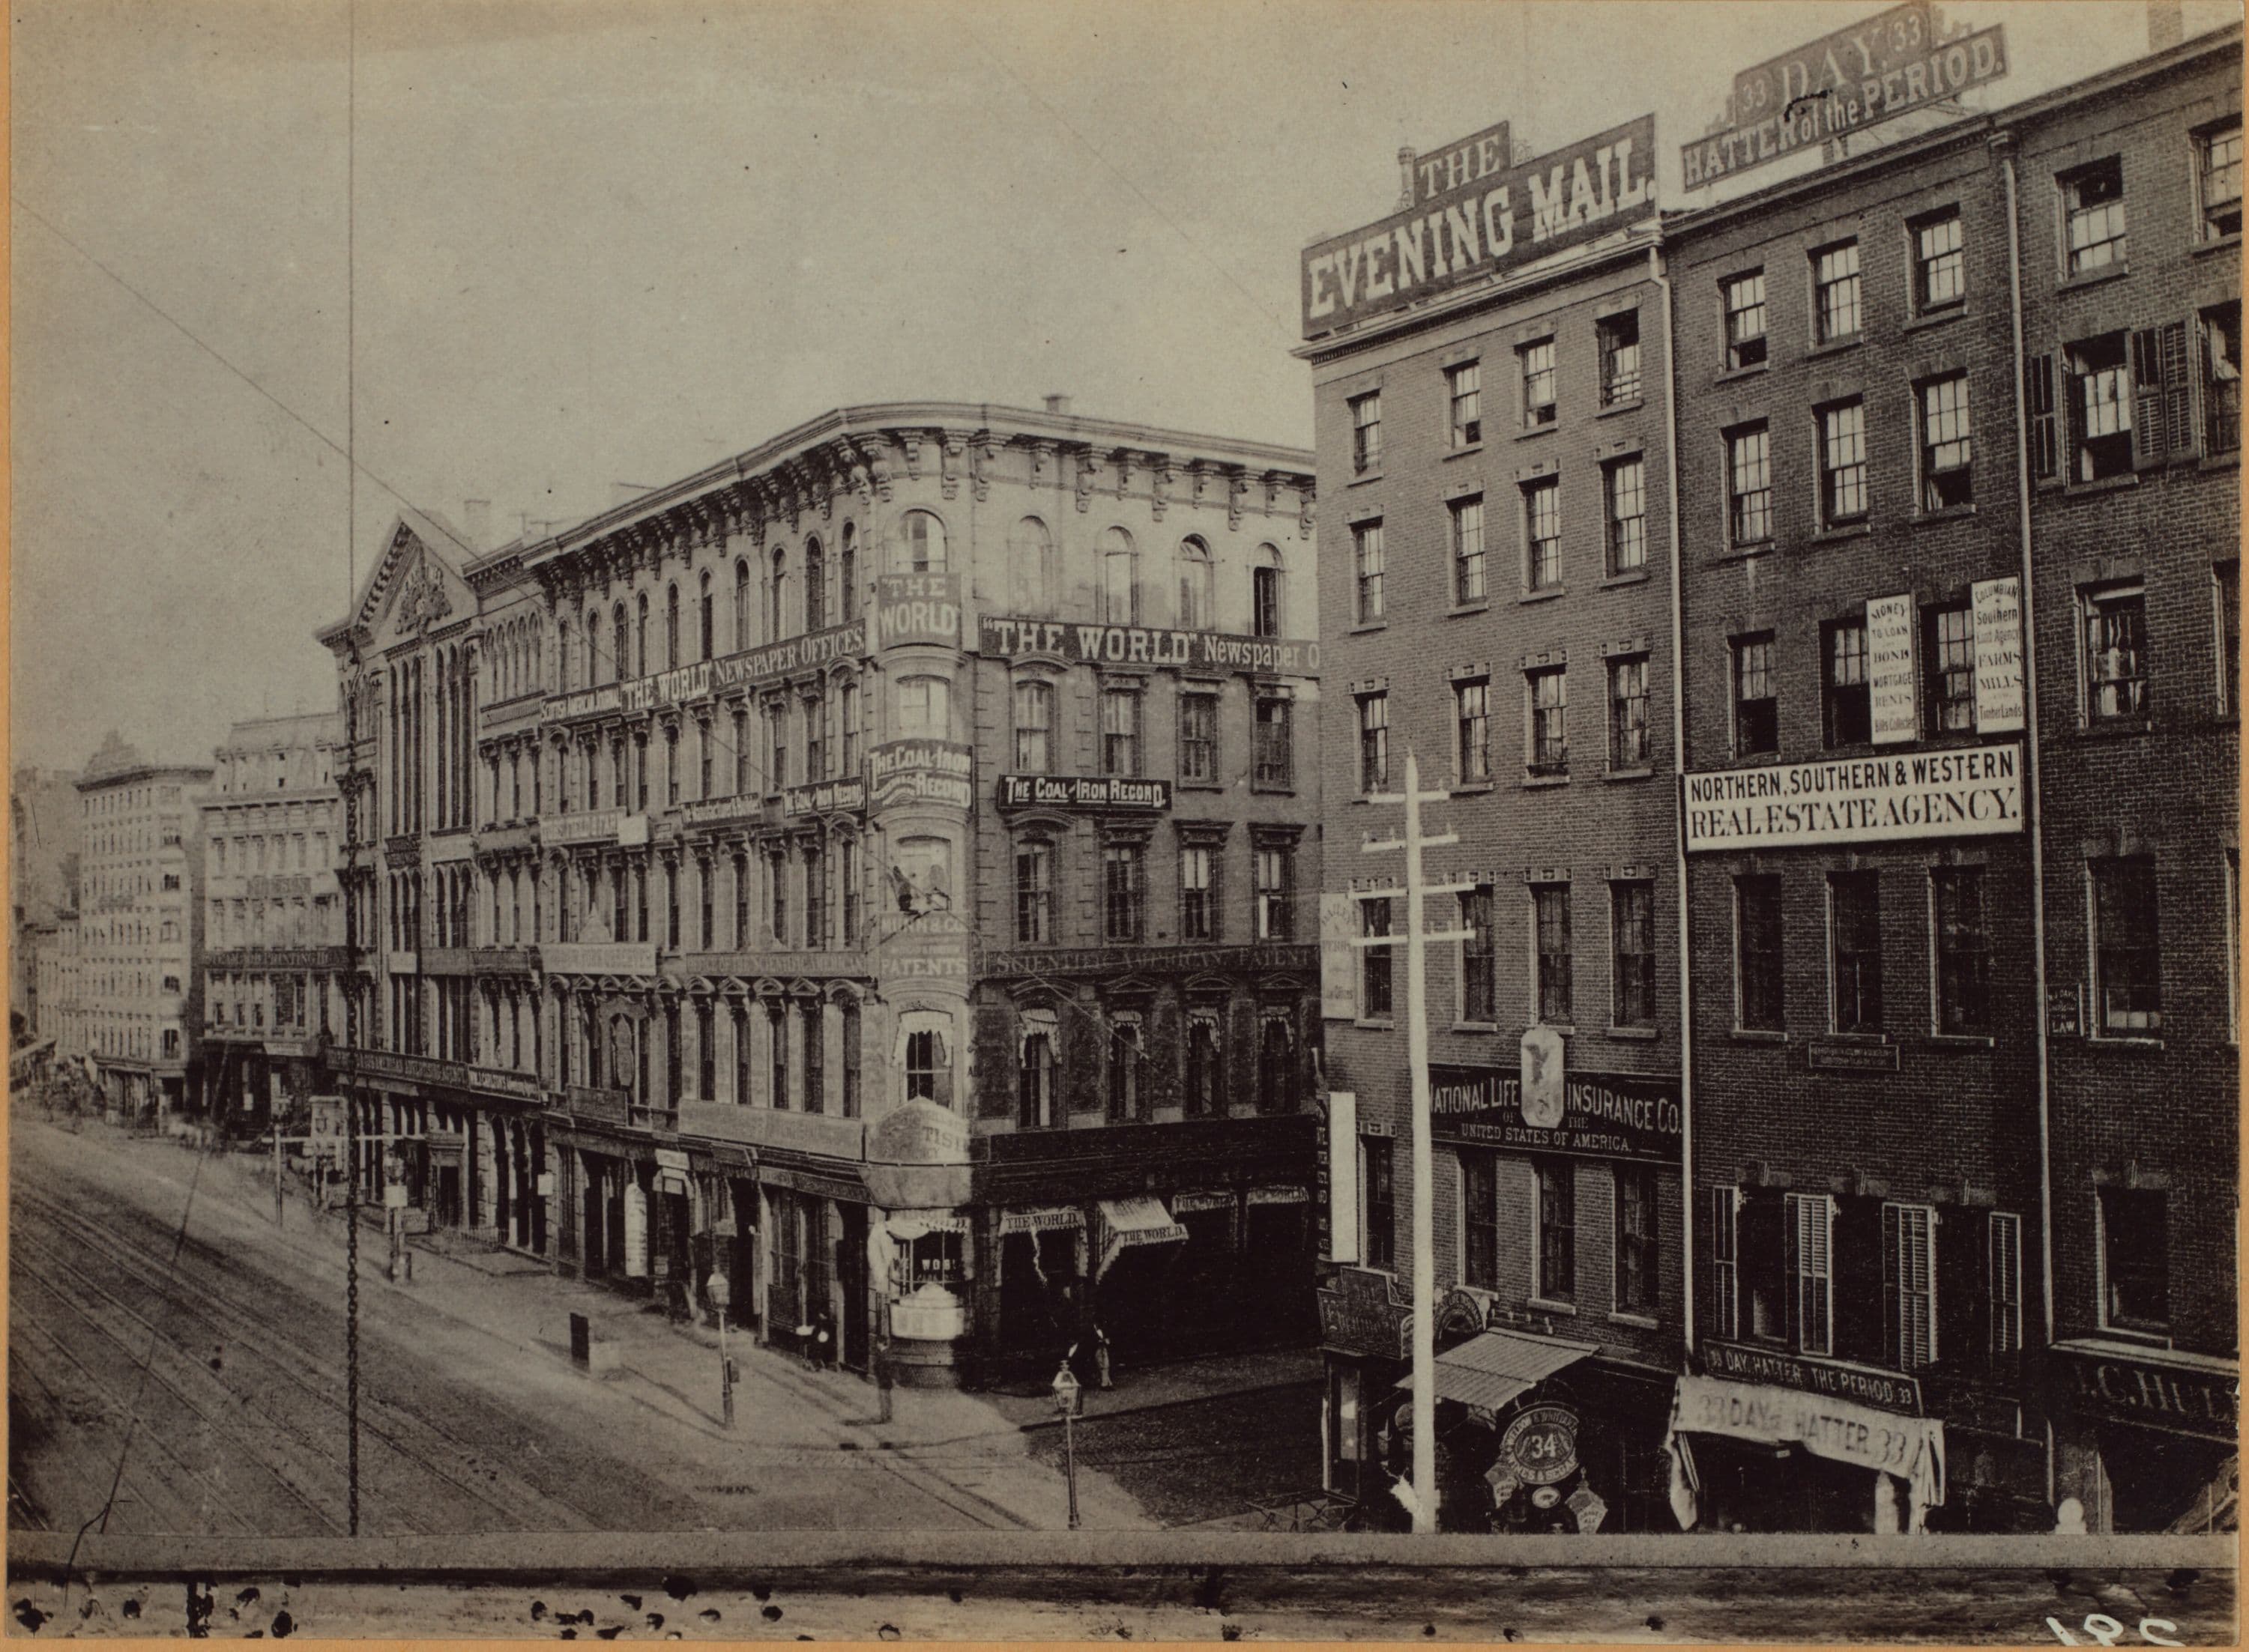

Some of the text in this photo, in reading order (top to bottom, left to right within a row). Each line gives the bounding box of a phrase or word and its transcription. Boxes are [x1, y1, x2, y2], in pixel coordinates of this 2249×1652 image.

[1742, 80, 1766, 111] 33
[1894, 16, 1921, 52] 33
[1683, 37, 2002, 185] HATTER of the PERIOD.
[1421, 135, 1499, 199] THE
[1308, 138, 1655, 318] EVENING MAIL.
[714, 645, 796, 686] NEWSPAPER
[1204, 638, 1300, 670] Newspaper
[1691, 751, 2014, 802] NORTHERN, SOUTHERN & WESTERN
[1691, 787, 2018, 838] REAL ESTATE AGENCY.
[882, 958, 967, 975] PATENTS
[1491, 1077, 1519, 1107] LIFE
[1568, 1083, 1653, 1131] INSURANCE
[1461, 1123, 1501, 1140] UNITED
[1506, 1128, 1549, 1146] STATES
[1554, 1132, 1569, 1147] OF
[1006, 1217, 1030, 1229] THE
[1123, 1230, 1143, 1244] THE
[1811, 1367, 1836, 1391] THE
[1898, 1388, 1912, 1405] 33
[1531, 1434, 1557, 1459] 34
[1877, 1428, 1907, 1465] 33
